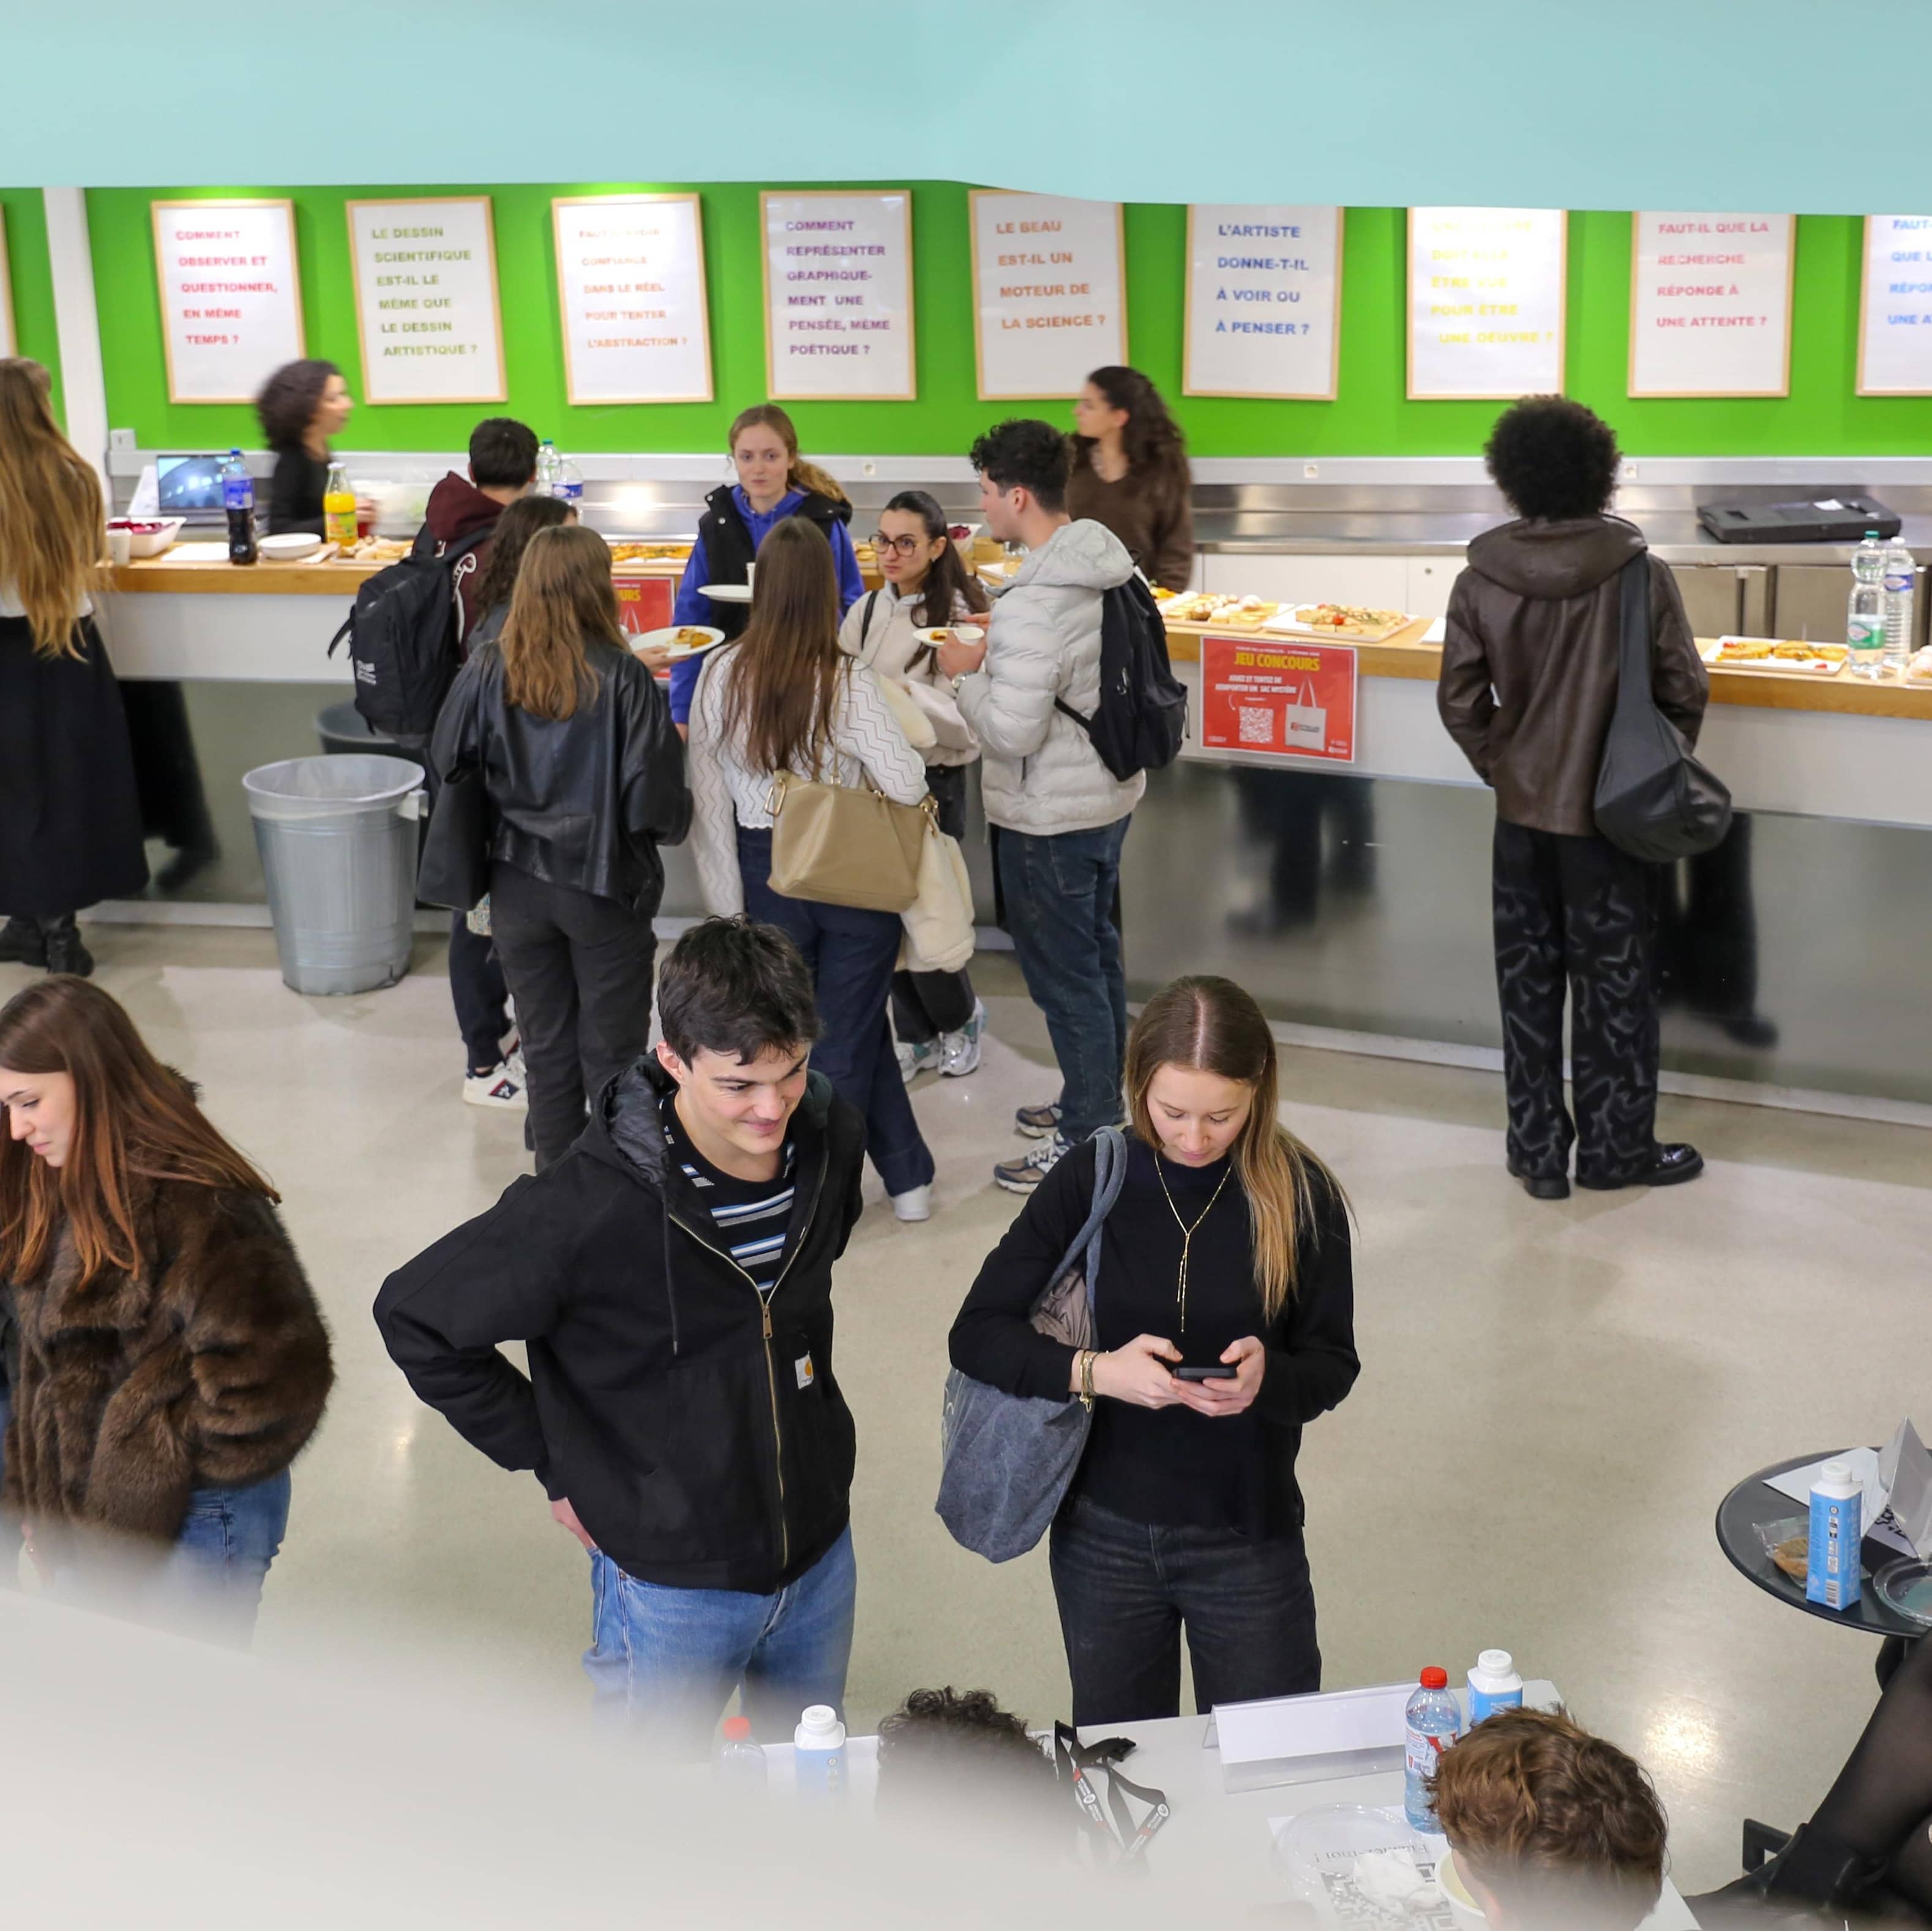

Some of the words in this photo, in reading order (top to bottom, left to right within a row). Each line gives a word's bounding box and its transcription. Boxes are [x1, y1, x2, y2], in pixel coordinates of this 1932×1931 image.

[785, 220, 855, 231] COMMENT
[996, 223, 1014, 234] LE
[1020, 221, 1062, 233] BEAU
[1218, 225, 1301, 238] L'ARTISTE
[1658, 223, 1710, 234] FAUT-IL
[1716, 222, 1746, 233] QUE
[1750, 222, 1769, 233] LA
[176, 230, 240, 241] COMMENT
[372, 228, 388, 239] LE
[393, 227, 444, 238] DESSIN
[786, 244, 886, 256] REPRÉSENTER
[178, 257, 247, 267] OBSERVER
[251, 256, 268, 266] ET
[374, 250, 471, 263] SCIENTIFIQUE
[998, 254, 1046, 266] EST-IL
[1050, 252, 1073, 264] UN
[1658, 254, 1745, 265] RECHERCHE
[1891, 251, 1920, 262] QUE
[1218, 257, 1309, 271] DONNE-T-IL
[376, 275, 419, 286] EST-IL
[423, 274, 440, 285] LE
[787, 271, 872, 281] GRAPHIQUE-
[181, 283, 278, 294] QUESTIONNER,
[584, 284, 615, 294] DANS
[618, 283, 631, 293] LE
[635, 282, 665, 292] RÉEL
[1000, 284, 1065, 298] MOTEUR
[1069, 283, 1090, 294] DE
[1657, 284, 1724, 296] RÉPONDE
[1729, 282, 1739, 294] À
[788, 296, 826, 306] MENT
[834, 296, 864, 306] UNE
[1216, 288, 1227, 300] À
[1232, 290, 1271, 301] VOIR
[1276, 291, 1300, 302] OU
[423, 298, 452, 308] QUE
[183, 309, 201, 319] EN
[204, 307, 242, 318] MÊME
[585, 311, 618, 321] POUR
[620, 310, 667, 320] TENTER
[1431, 304, 1473, 316] POUR
[789, 318, 846, 331] PENSÉE,
[1002, 318, 1020, 329] LA
[1026, 315, 1093, 328] SCIENCE
[1097, 314, 1106, 325] ?
[1657, 317, 1685, 328] UNE
[1690, 316, 1755, 327] ATTENTE
[1759, 316, 1767, 326] ?
[1888, 314, 1917, 325] UNE
[381, 323, 397, 333] LE
[402, 322, 452, 332] DESSIN
[1216, 320, 1227, 332] À
[1232, 322, 1296, 334] PENSER
[1301, 324, 1309, 335] ?
[185, 335, 229, 345] TEMPS
[233, 335, 240, 344] ?
[1439, 332, 1471, 343] UNE
[1476, 331, 1539, 343] OEUVRE
[1545, 331, 1554, 342] ?
[383, 345, 466, 356] ARTISTIQUE
[471, 345, 477, 354] ?
[790, 343, 859, 355] POÉTIQUE
[863, 344, 871, 354] ?
[1234, 651, 1254, 667] JEU
[1256, 653, 1321, 672] CONCOURS
